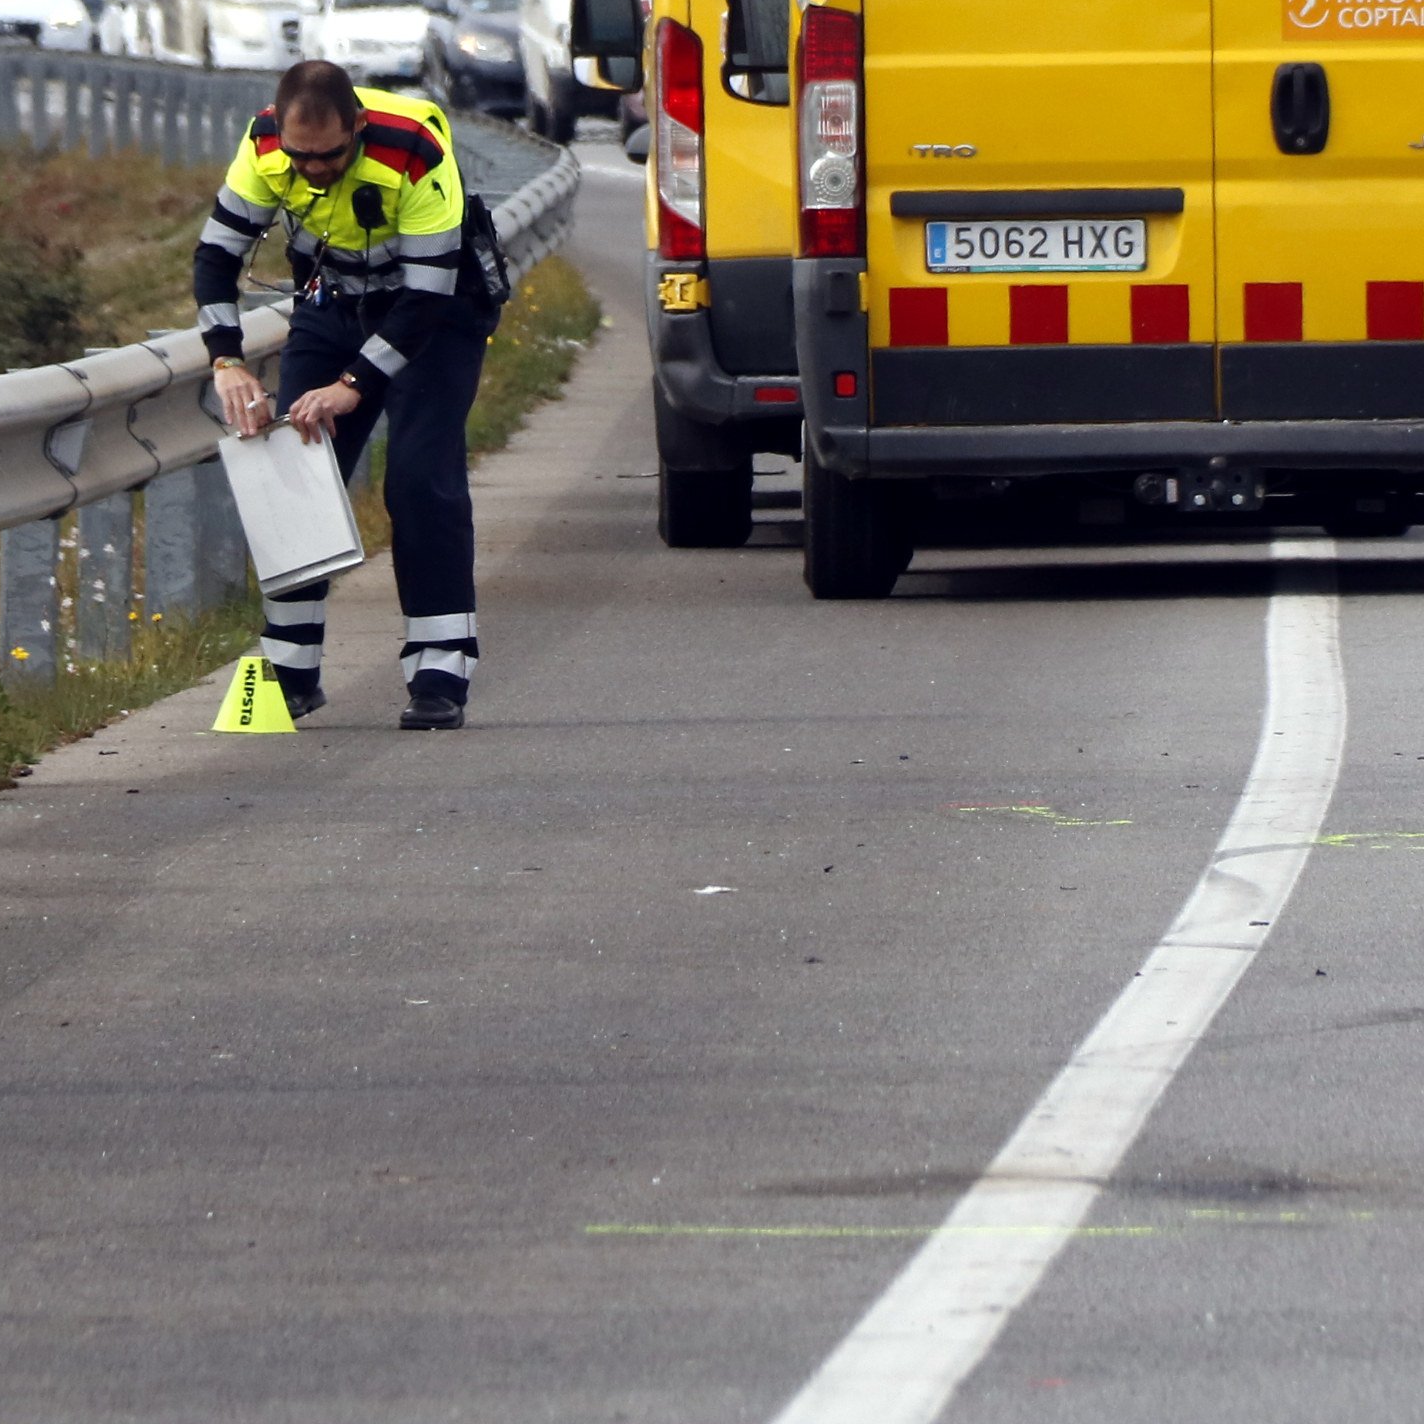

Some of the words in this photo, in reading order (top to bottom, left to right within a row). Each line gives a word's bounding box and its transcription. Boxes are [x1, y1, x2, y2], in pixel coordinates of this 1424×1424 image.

[913, 143, 978, 158] TRO
[954, 227, 1048, 259] 5062
[1063, 226, 1135, 259] HXG
